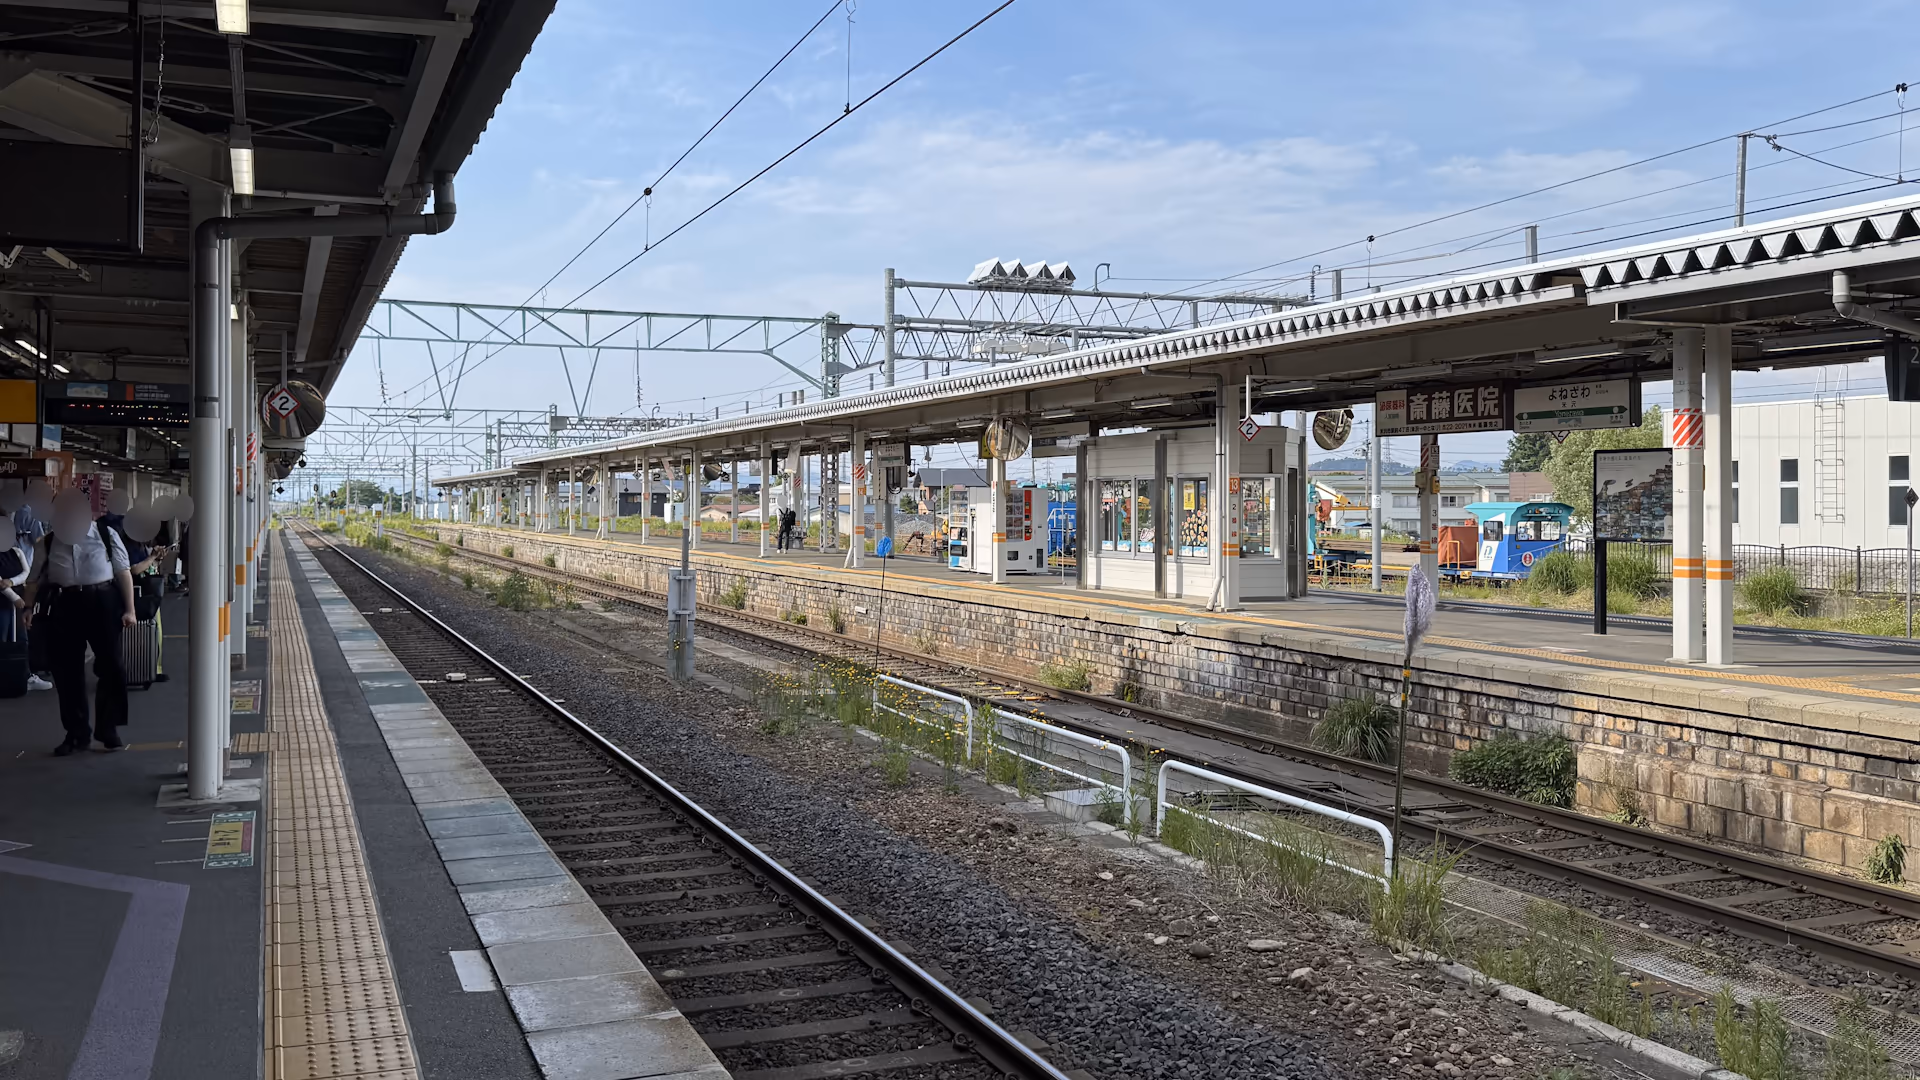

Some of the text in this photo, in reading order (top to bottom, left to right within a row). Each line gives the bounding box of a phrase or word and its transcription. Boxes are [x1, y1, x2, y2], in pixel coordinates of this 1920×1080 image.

[1910, 346, 1920, 364] 2
[1548, 385, 1591, 401] よねざわ
[278, 396, 290, 411] 2
[1409, 386, 1499, 421] 斎藤医院
[1554, 410, 1585, 418] Yonezawa
[1246, 423, 1253, 435] 2
[653, 473, 661, 481] 2
[1230, 478, 1238, 489] 13
